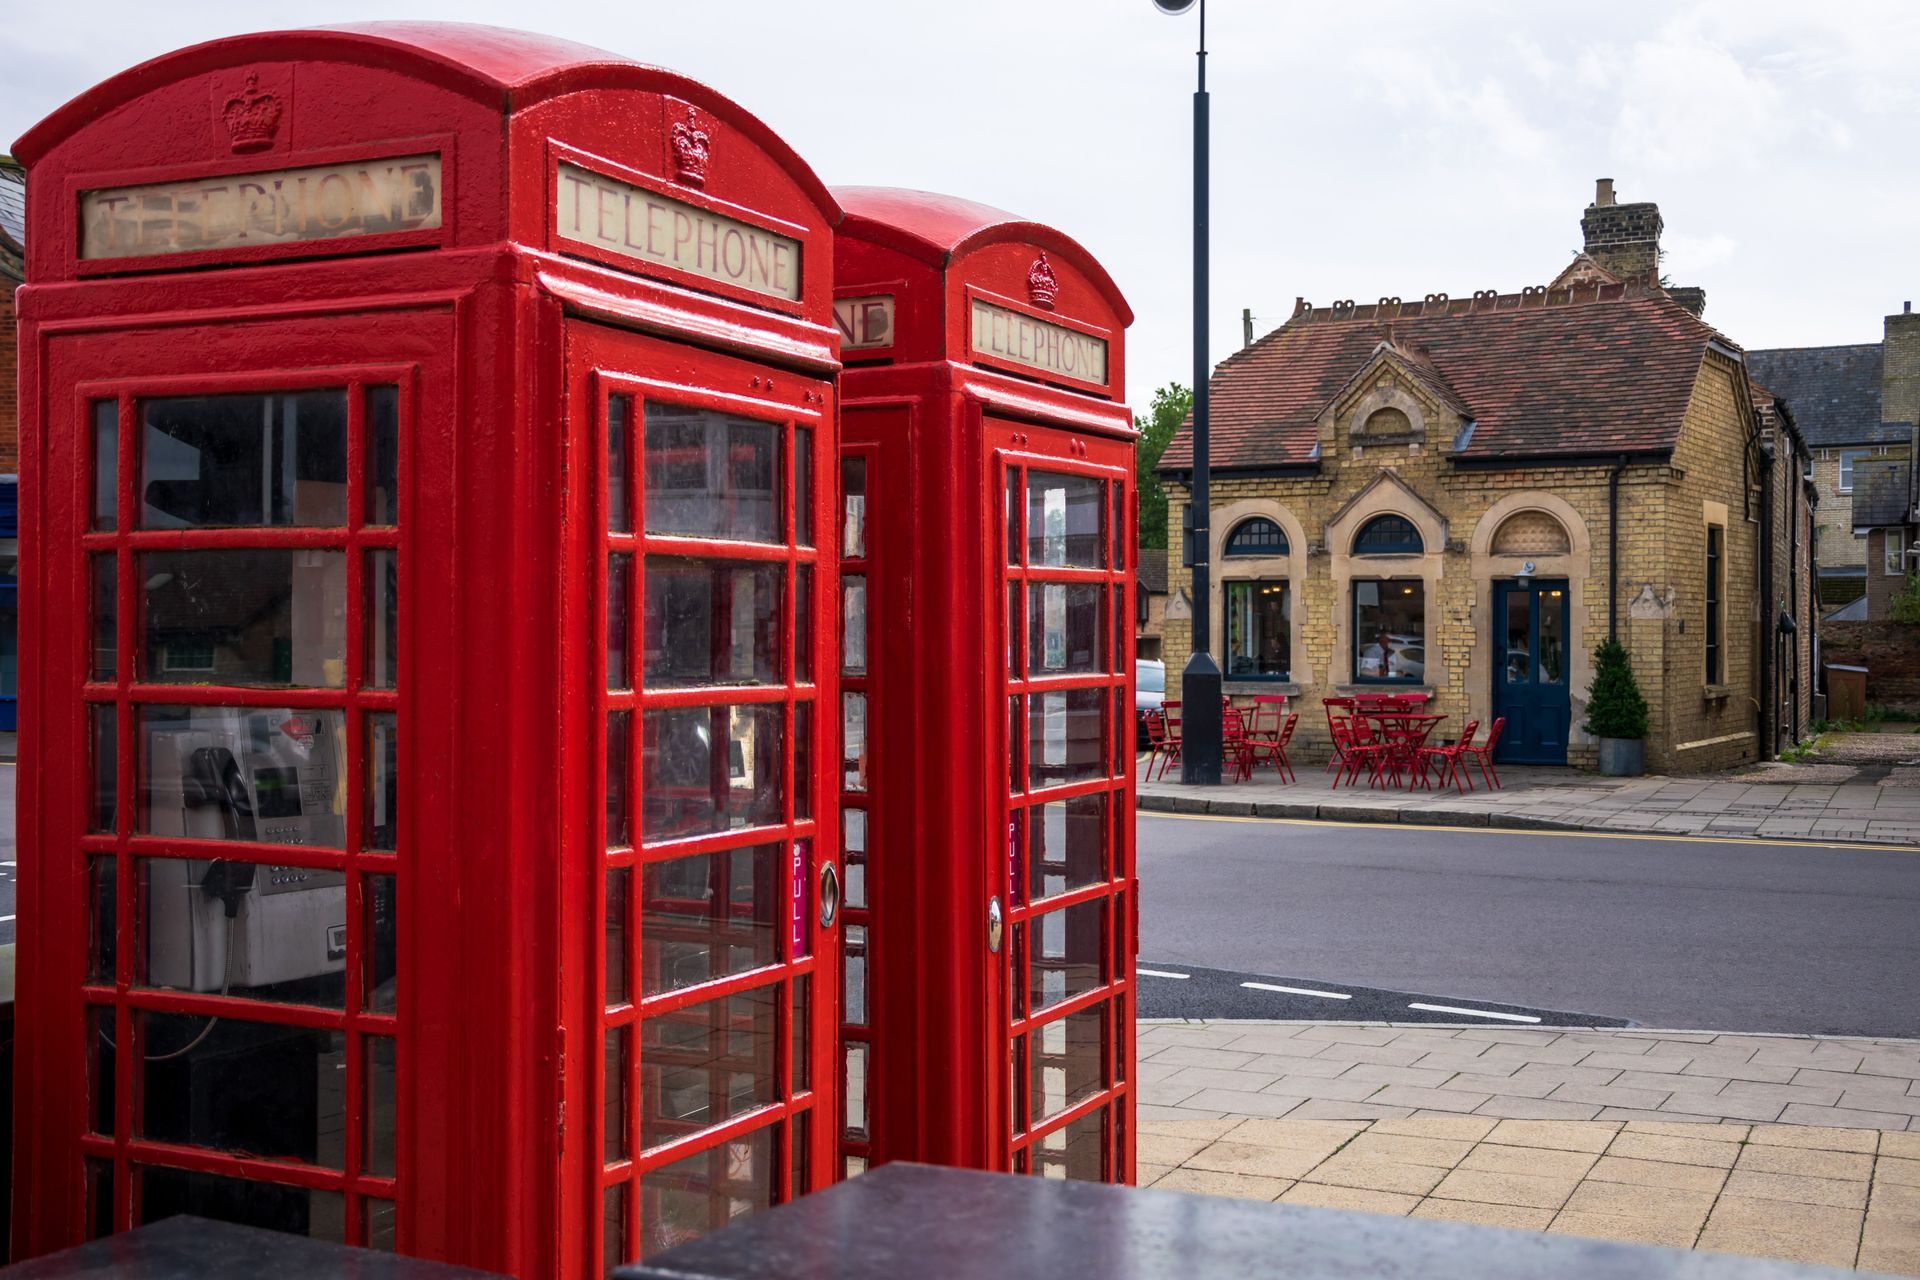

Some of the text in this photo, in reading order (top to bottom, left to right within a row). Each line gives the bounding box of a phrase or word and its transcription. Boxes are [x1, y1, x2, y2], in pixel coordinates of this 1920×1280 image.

[564, 174, 790, 293] TELEPHONE
[973, 307, 1101, 380] TELEPHONE
[1008, 822, 1016, 895] PULL
[793, 856, 802, 943] PULL
